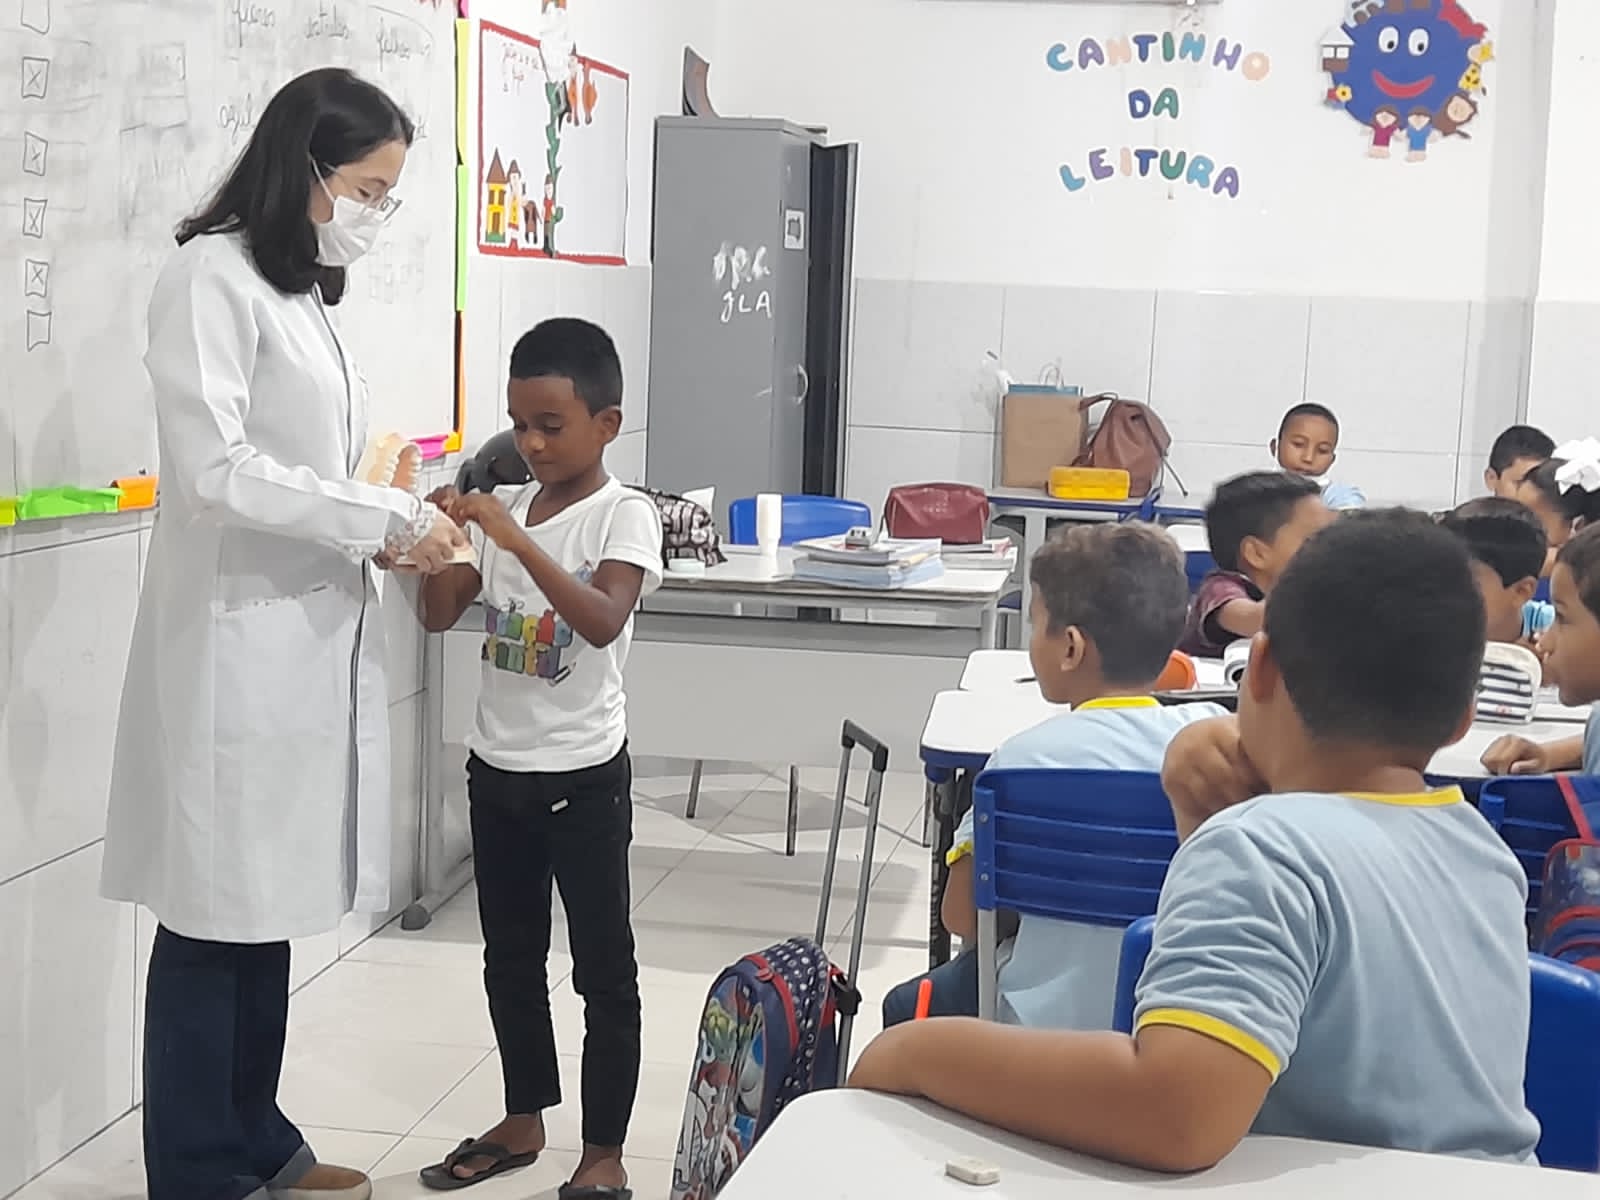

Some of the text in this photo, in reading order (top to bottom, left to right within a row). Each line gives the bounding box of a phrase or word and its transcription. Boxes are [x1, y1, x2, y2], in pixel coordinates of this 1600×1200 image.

[1046, 31, 1270, 81] CANTINHO
[1128, 87, 1179, 119] DA
[1059, 147, 1239, 198] LEITURA
